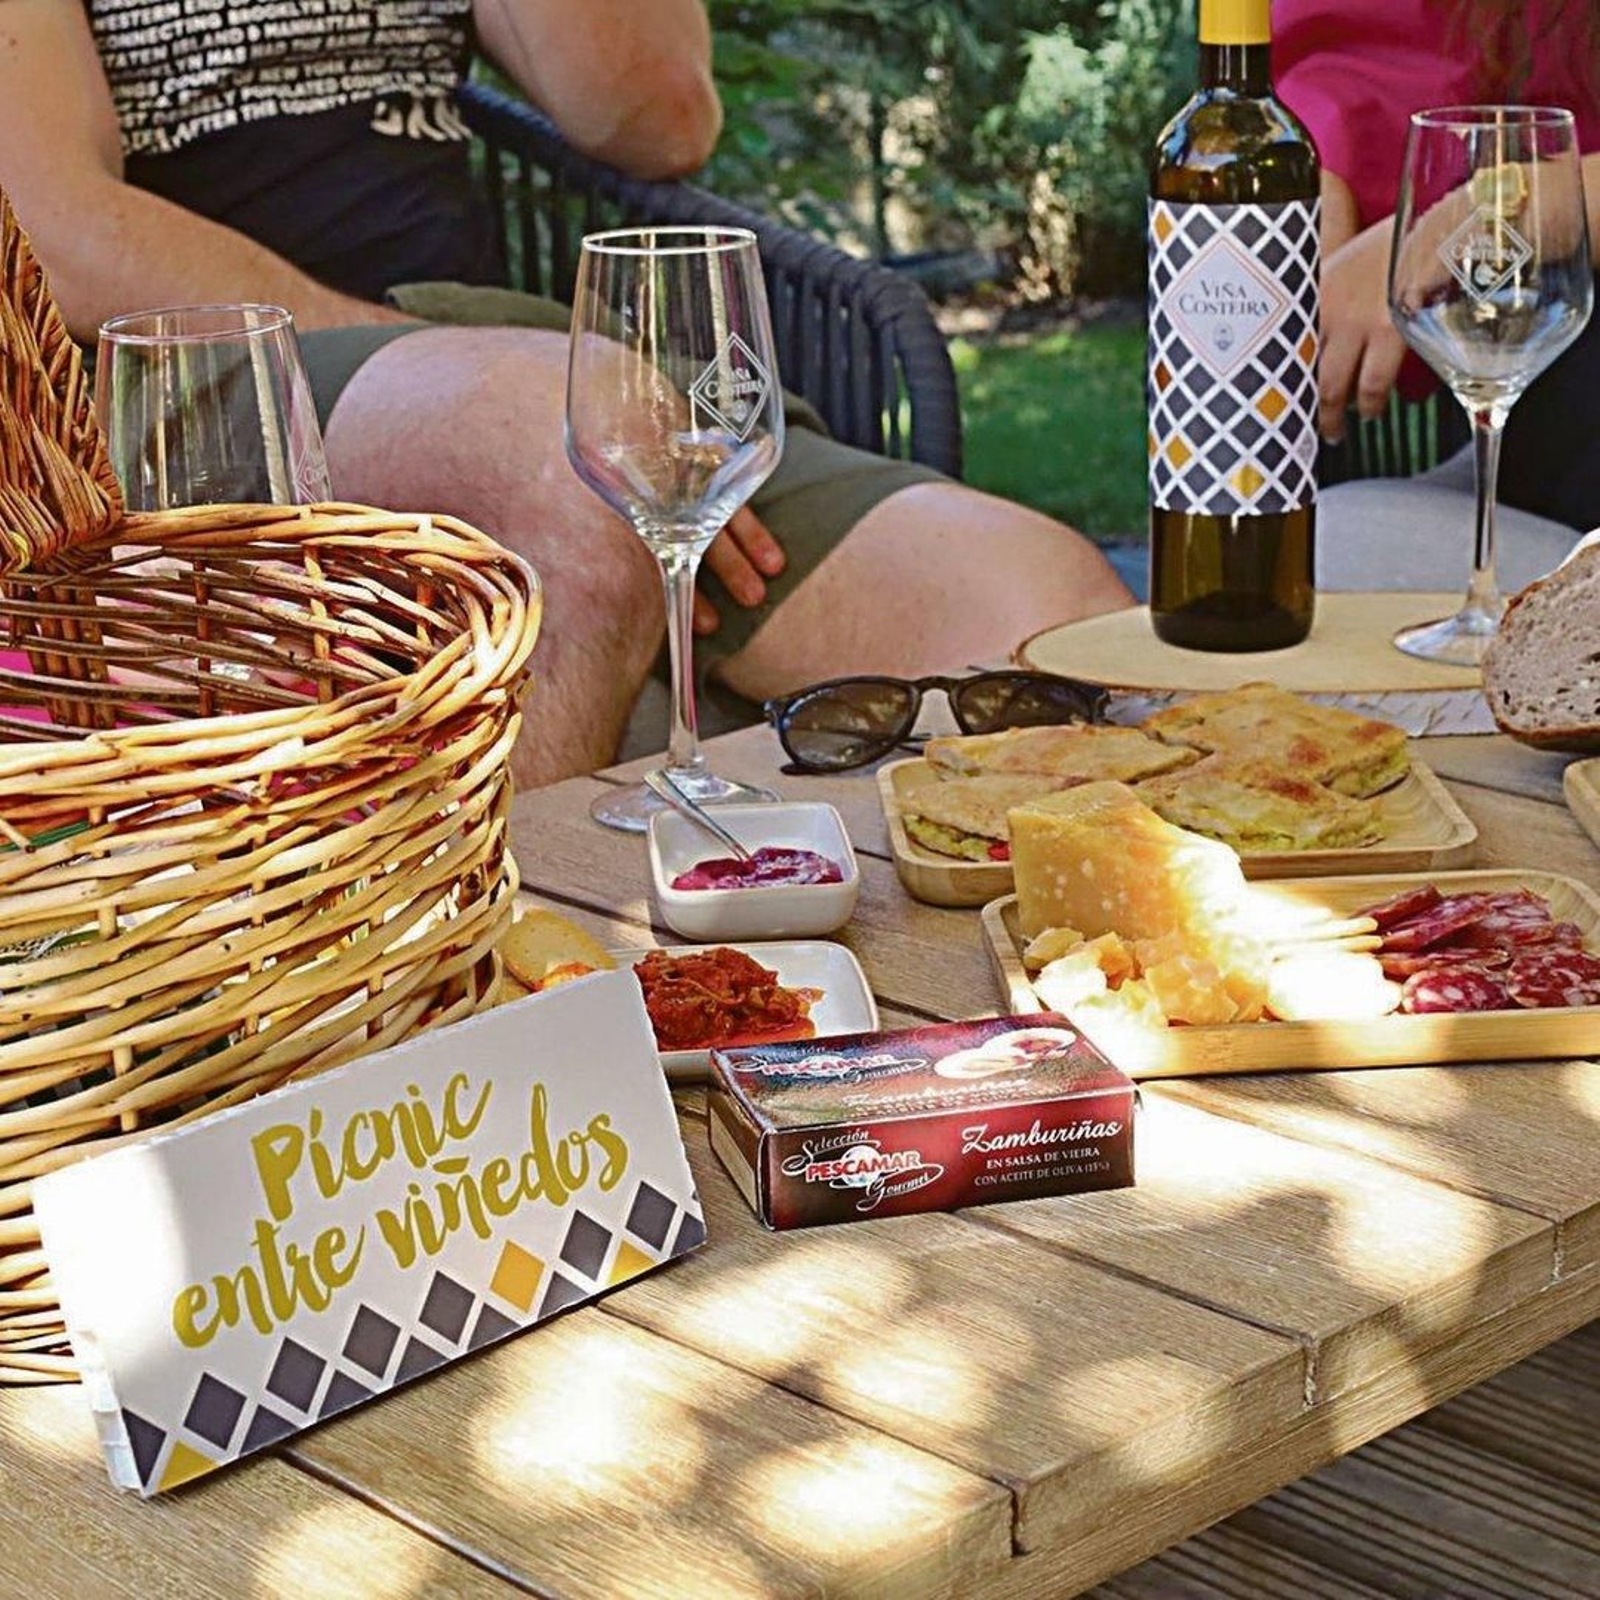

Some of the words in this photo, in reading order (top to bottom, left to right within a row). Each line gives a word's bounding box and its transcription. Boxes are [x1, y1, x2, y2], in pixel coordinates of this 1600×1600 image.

[1178, 293, 1270, 317] COSTEIRA
[784, 1129, 872, 1172] Selección
[962, 1119, 1122, 1154] Zamburiñas
[806, 1150, 922, 1182] PESCAMAR
[974, 1174, 998, 1186] CON
[1000, 1170, 1034, 1184] ACEITE
[1037, 1167, 1050, 1178] DE
[1052, 1164, 1083, 1176] OLIVA
[986, 1159, 1002, 1170] EN
[1005, 1154, 1041, 1168] SALSA
[1044, 1151, 1059, 1162] DE
[1062, 1147, 1100, 1159] VIEIRA
[857, 1170, 933, 1211] Gourmet
[171, 1218, 366, 1349] entre
[375, 1082, 630, 1270] viñedos
